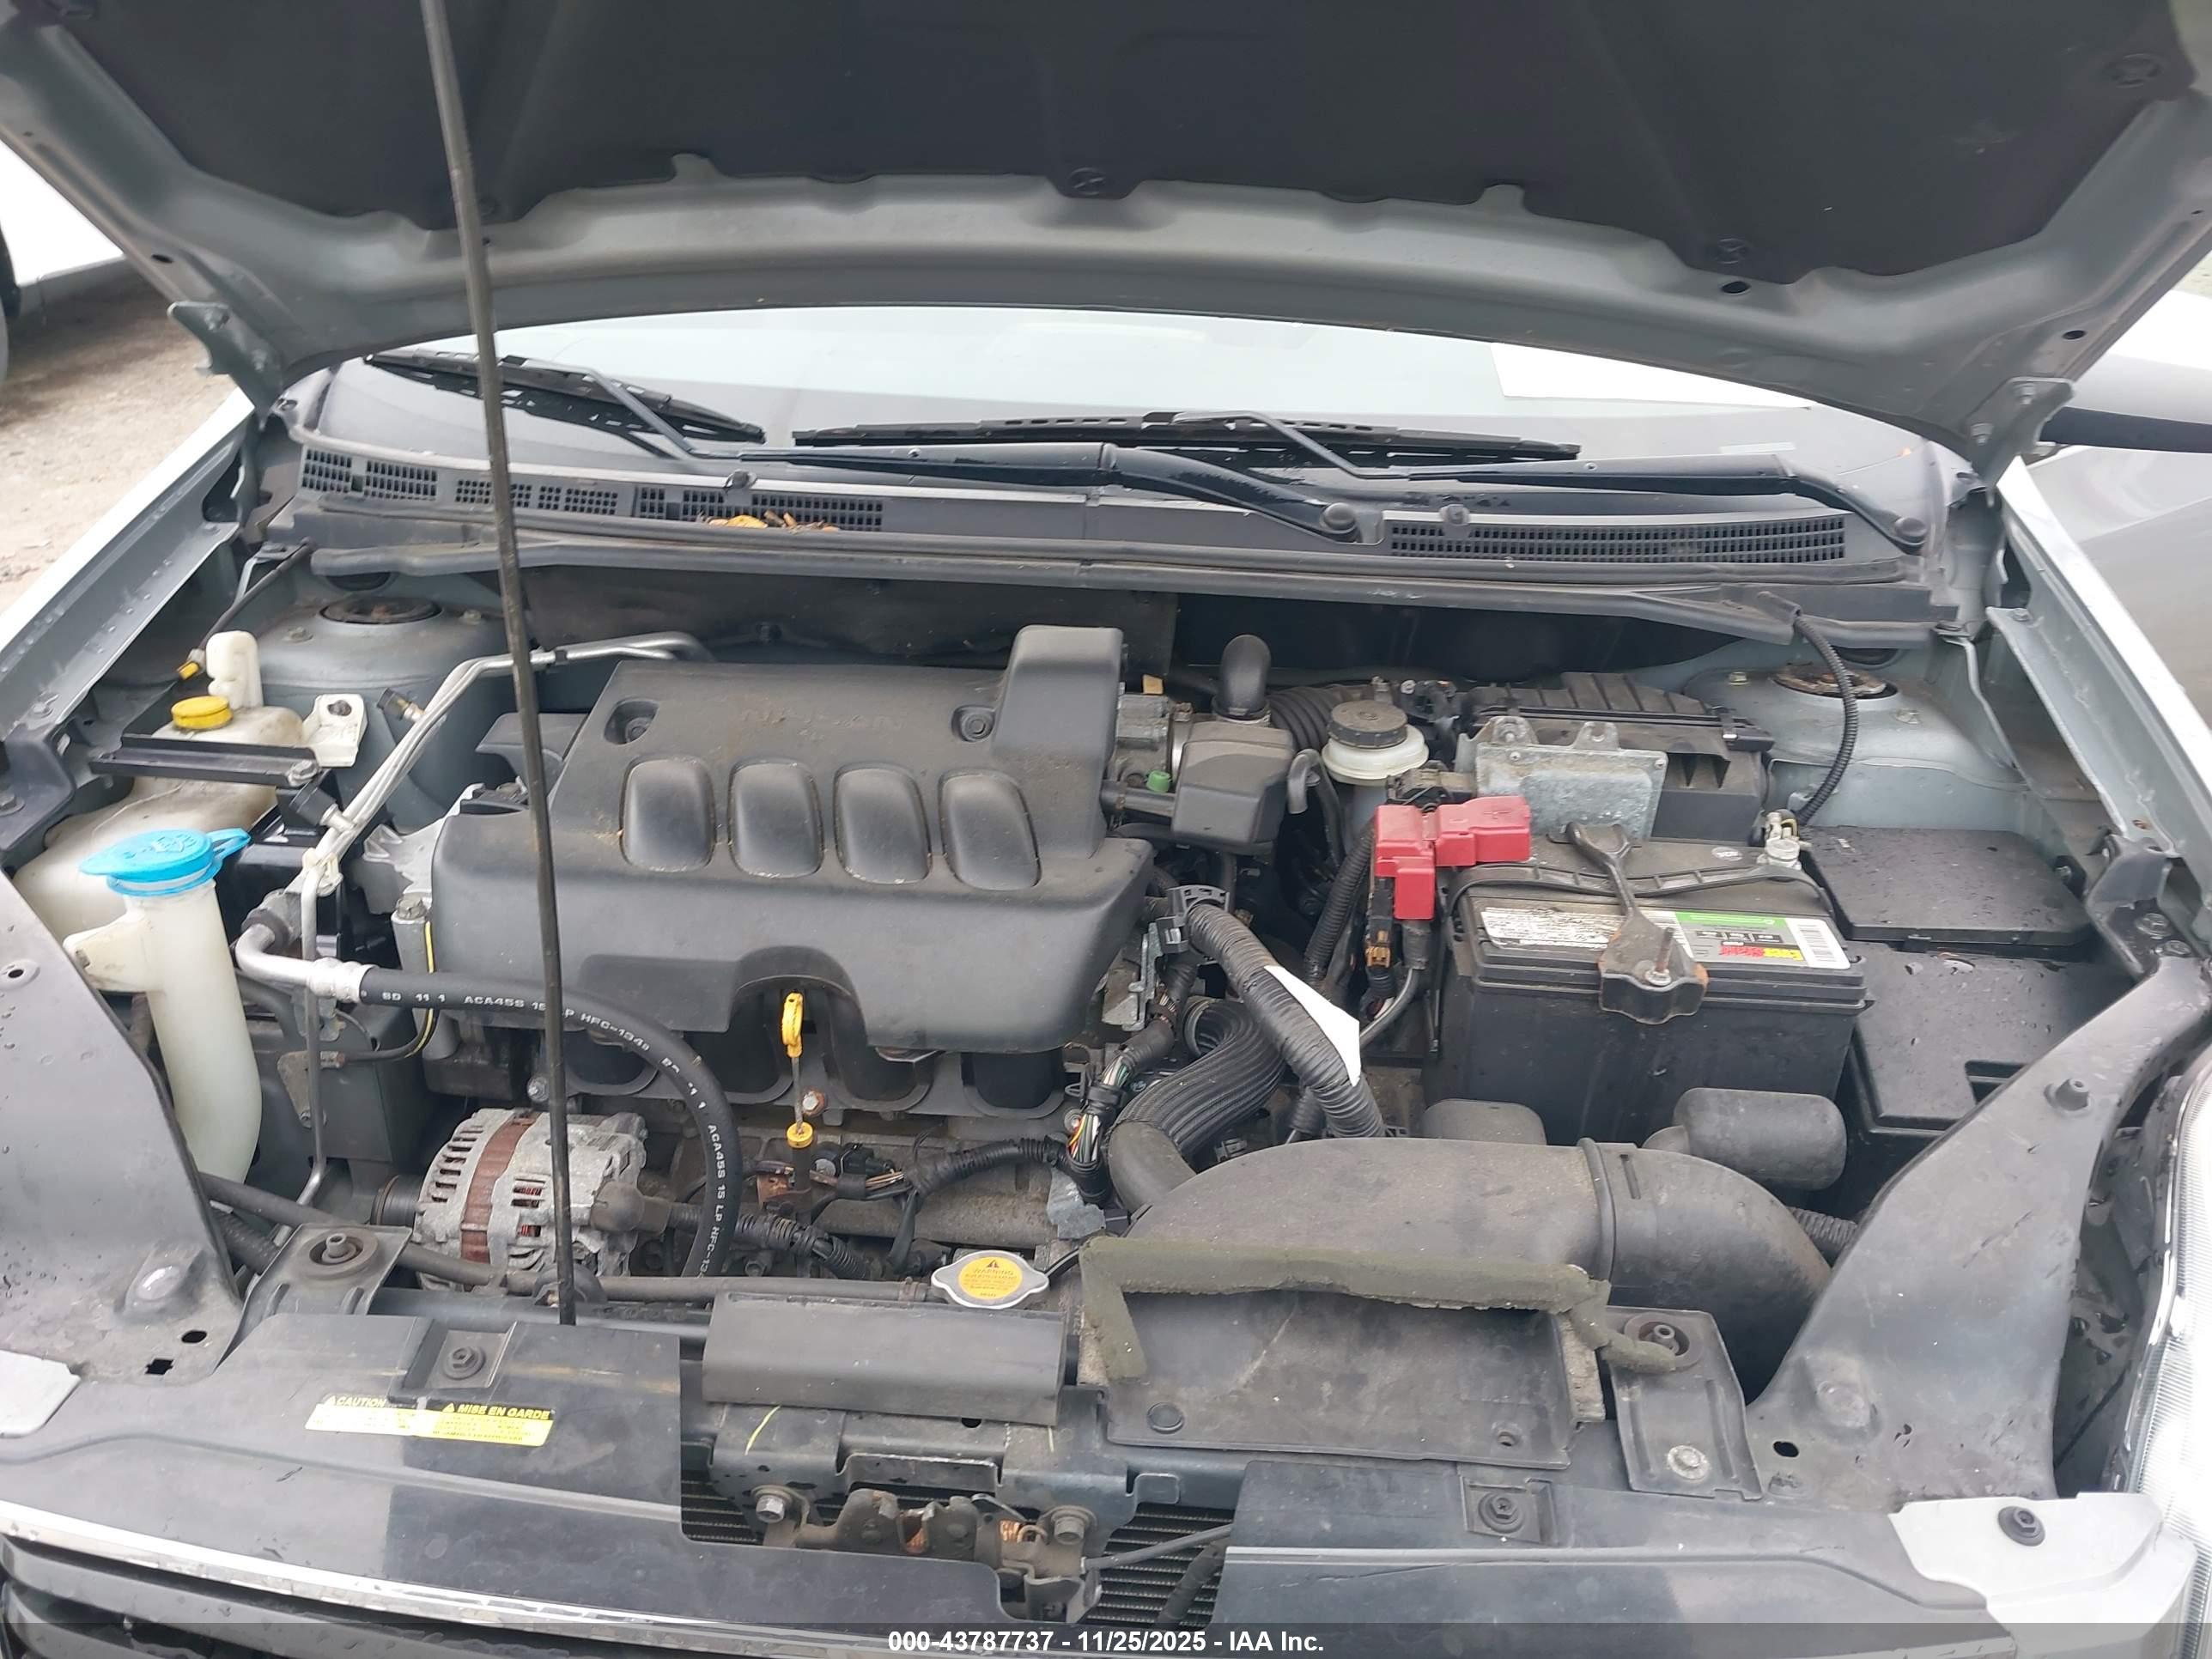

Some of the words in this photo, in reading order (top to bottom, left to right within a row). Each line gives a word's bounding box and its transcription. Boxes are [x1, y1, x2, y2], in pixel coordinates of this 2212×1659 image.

[464, 995, 526, 1008] ACA45S
[708, 1124, 726, 1179] ACA45S
[717, 1184, 726, 1200] 15
[714, 1204, 724, 1222] LP
[336, 1396, 386, 1408] CAUTION
[457, 1404, 488, 1415] MISE
[488, 1406, 506, 1417] EN
[507, 1407, 550, 1420] GARDE
